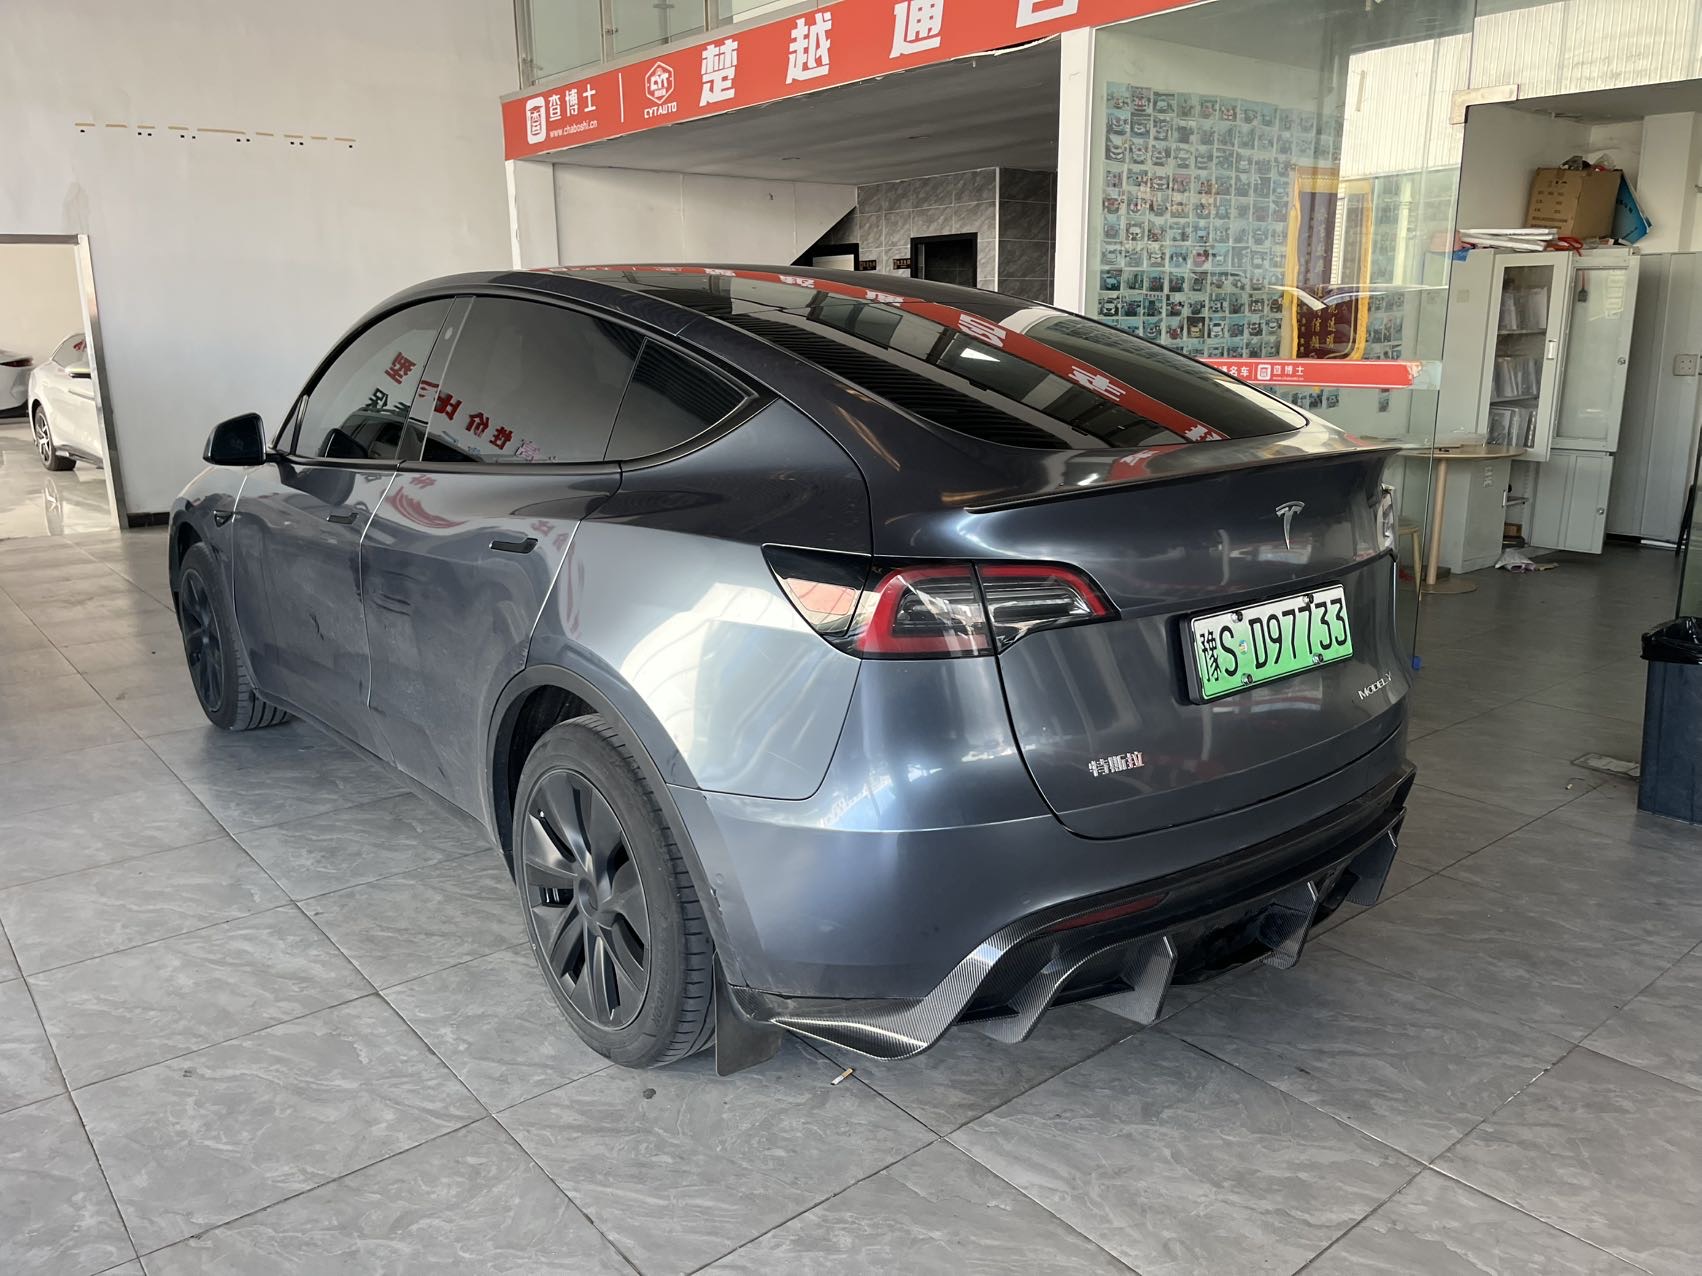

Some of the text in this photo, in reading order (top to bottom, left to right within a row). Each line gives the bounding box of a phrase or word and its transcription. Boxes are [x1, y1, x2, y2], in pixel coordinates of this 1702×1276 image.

[548, 84, 597, 121] 查博士
[644, 101, 678, 119] CYTAUTO
[549, 119, 598, 138] www.chaboshi.cn
[1088, 751, 1145, 777] 特斯拉
